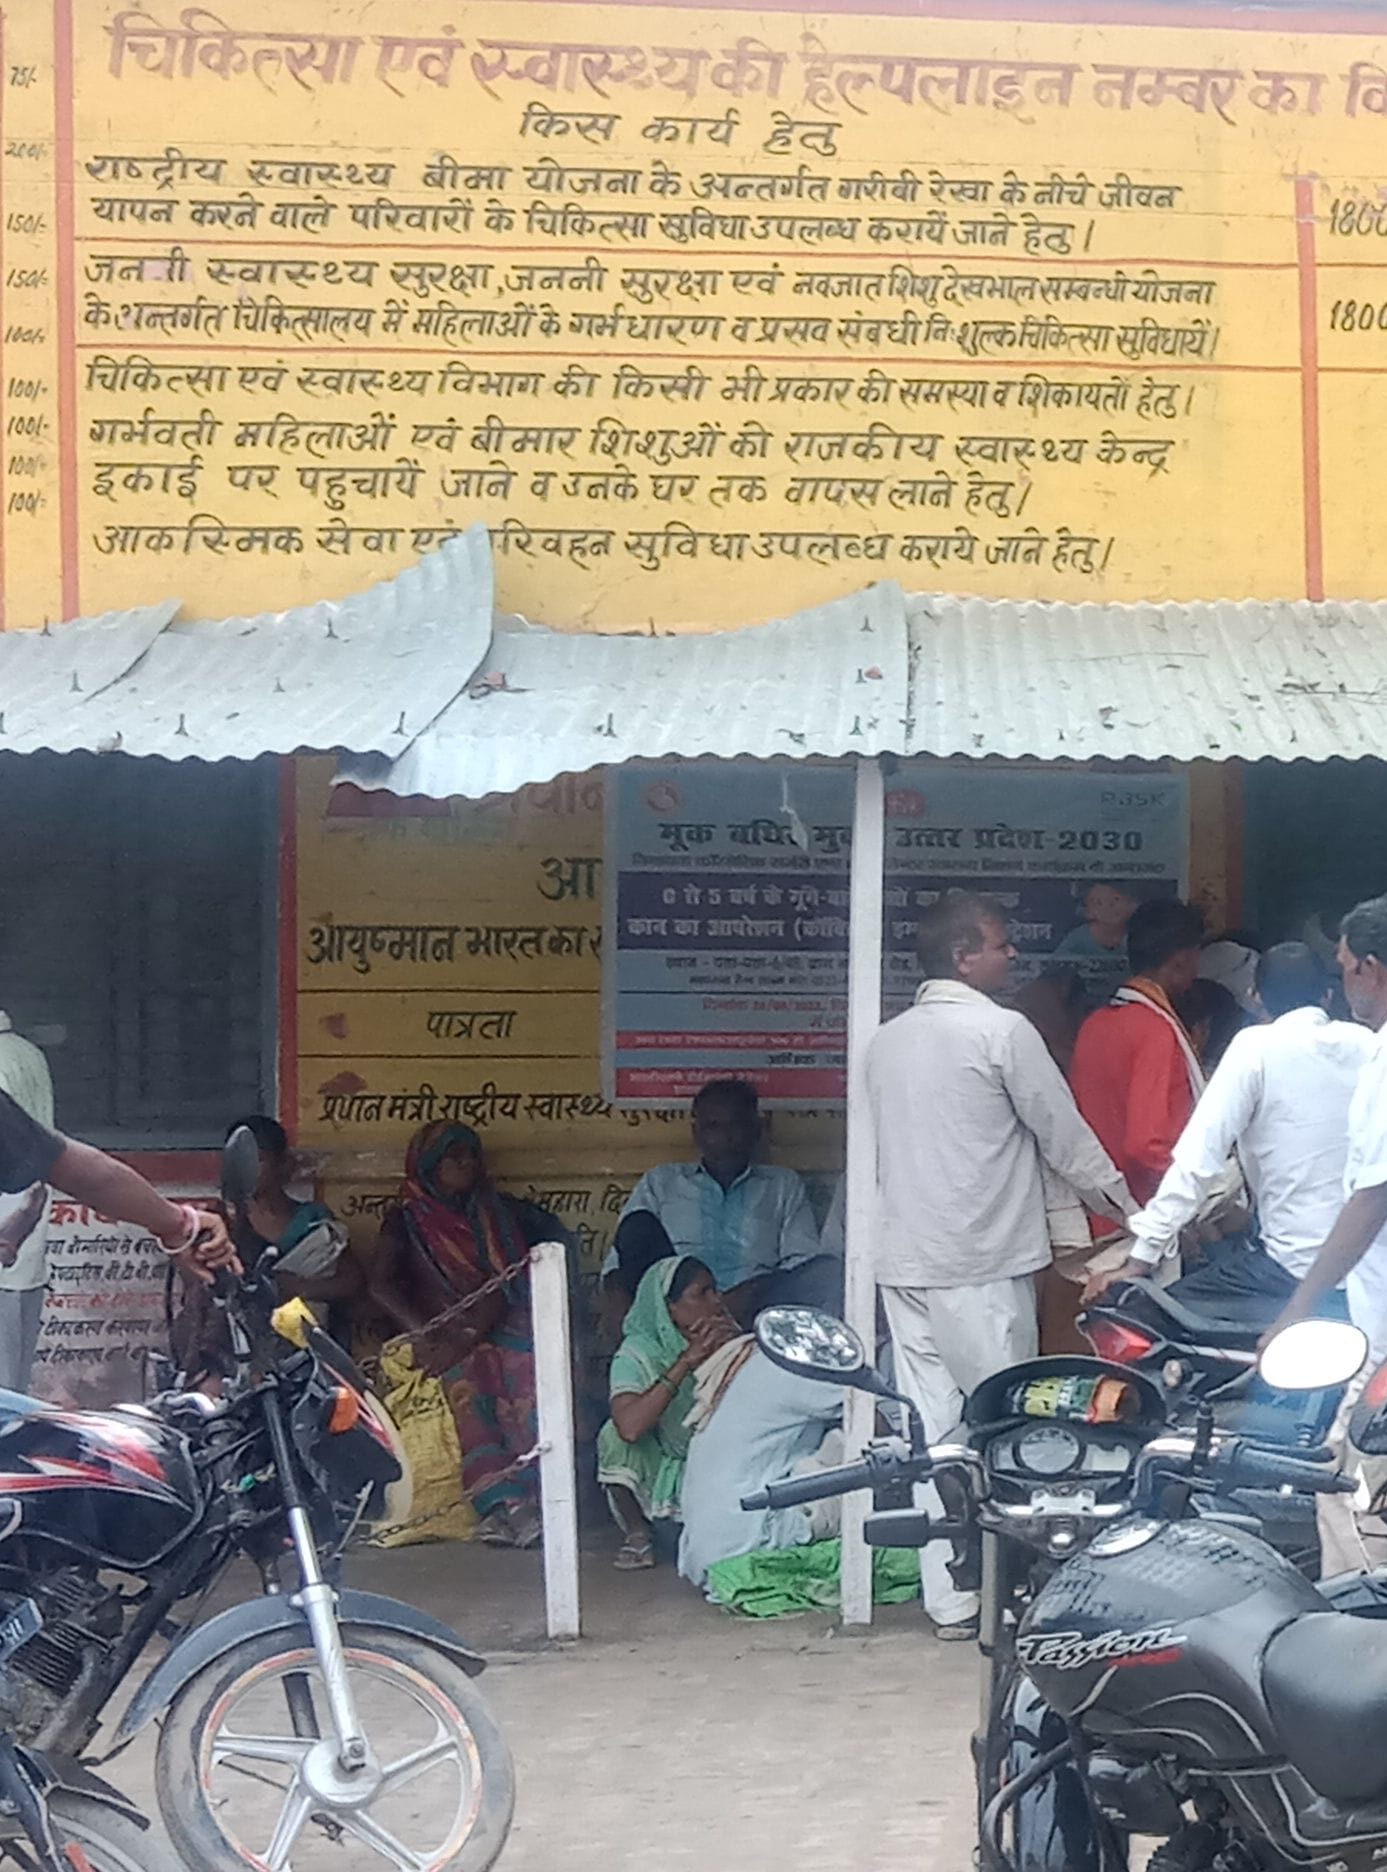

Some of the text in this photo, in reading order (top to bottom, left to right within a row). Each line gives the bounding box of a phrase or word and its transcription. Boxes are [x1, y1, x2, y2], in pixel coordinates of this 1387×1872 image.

[102, 8, 364, 97] चिकित्सा
[375, 24, 465, 97] एवं
[470, 39, 712, 102] स्वास्थ्य
[711, 36, 789, 99] की
[797, 32, 1081, 124] हेल्पलाइन
[1092, 64, 1243, 126] नम्बर
[1249, 70, 1328, 116] का
[519, 102, 842, 157] किस कार्य हेतु
[249, 159, 395, 189] स्वास्थ्य
[423, 155, 512, 191] बीमा
[523, 157, 642, 196] योजना
[649, 159, 681, 196] के
[689, 165, 831, 202] अन्तर्गत
[929, 171, 992, 203] रेखा
[999, 171, 1028, 205] के
[1033, 173, 1096, 208] नीचे
[1100, 173, 1182, 209] जीवन
[91, 192, 1017, 247] यापन करने वाले परिवारों के चिकित्सा सुविधा उपलब्ध करायें जाने
[206, 257, 381, 290] स्वास्थ्य
[504, 256, 608, 294] जननी
[620, 266, 722, 304] सुरक्षा
[730, 263, 784, 300] एवं
[792, 271, 886, 303] नवजात
[888, 265, 940, 308] शिशु
[941, 265, 1039, 307] देखभाल
[1132, 270, 1217, 305] योजना
[84, 292, 110, 329] के
[233, 295, 376, 343] चिकित्सालय
[382, 299, 410, 333] में
[412, 301, 537, 347] महिलाओं
[538, 303, 560, 338] के
[732, 316, 754, 344] व
[755, 316, 832, 348] प्रसव
[1020, 316, 1114, 356] चिकित्सा
[85, 355, 1131, 418] चिकित्सा एवं स्वास्थ्य विभाग की किसी भी प्रकार की समस्या व शिकायतों
[90, 407, 1176, 478] गर्भवती महिलाओं एवं बीमार शिशुओं को राजकीय स्वास्थ्य केन्द्र
[93, 455, 204, 503] इकाई
[228, 465, 280, 498] पर
[440, 460, 518, 499] जाने
[530, 471, 558, 499] व
[562, 464, 638, 502] उनके
[650, 475, 699, 507] घर
[708, 476, 767, 507] तक
[784, 476, 882, 510] वापस
[888, 471, 958, 511] लाने
[93, 514, 304, 556] आकस्मिक
[315, 518, 407, 557] सेवा
[489, 518, 616, 570] रिवहन
[624, 522, 750, 570] सुविधा
[985, 527, 1049, 566] जाने
[658, 823, 716, 851] मूक
[896, 827, 963, 850] उत्तर
[307, 924, 588, 975] आयुष्मान भारत का
[427, 1010, 518, 1039] पात्रता
[319, 1094, 386, 1128] प्रधान
[439, 1082, 522, 1126] राष्ट्रीय
